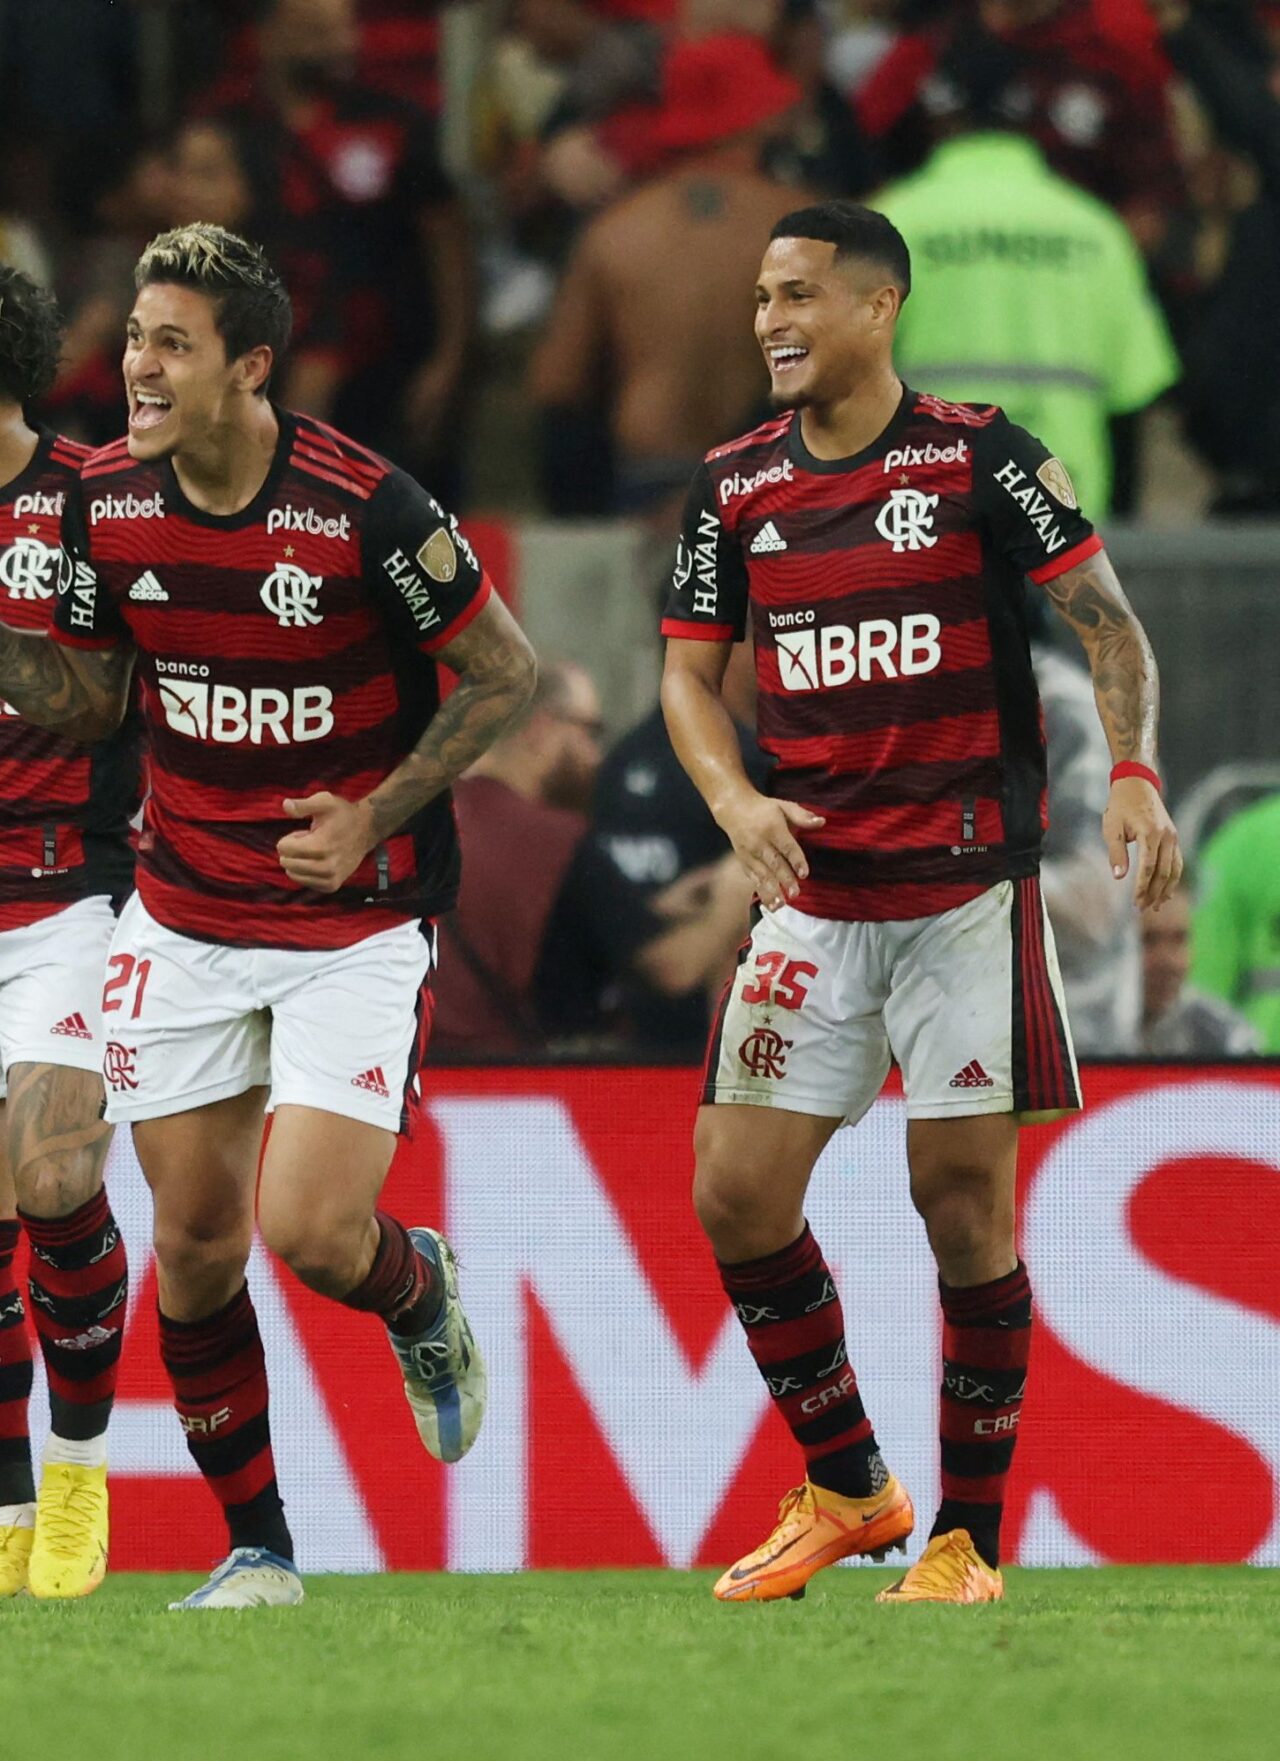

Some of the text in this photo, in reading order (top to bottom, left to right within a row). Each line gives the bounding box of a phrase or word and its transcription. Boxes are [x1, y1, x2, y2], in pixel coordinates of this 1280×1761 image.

[883, 439, 968, 474] pixbet
[720, 458, 794, 505] pixbet
[90, 492, 165, 526] pixbet
[267, 504, 351, 542] pixbet
[993, 459, 1067, 554] HAVAN
[693, 509, 721, 617] HAVAN
[128, 587, 169, 602] adidas
[382, 548, 442, 631] HAVAN
[769, 609, 815, 628] banco
[155, 658, 210, 677] banco
[820, 613, 942, 687] BRB
[212, 684, 335, 745] BRB
[102, 953, 152, 1020] 21
[741, 951, 819, 1010] 35
[50, 1027, 93, 1041] adidas
[350, 1078, 390, 1099] adidas
